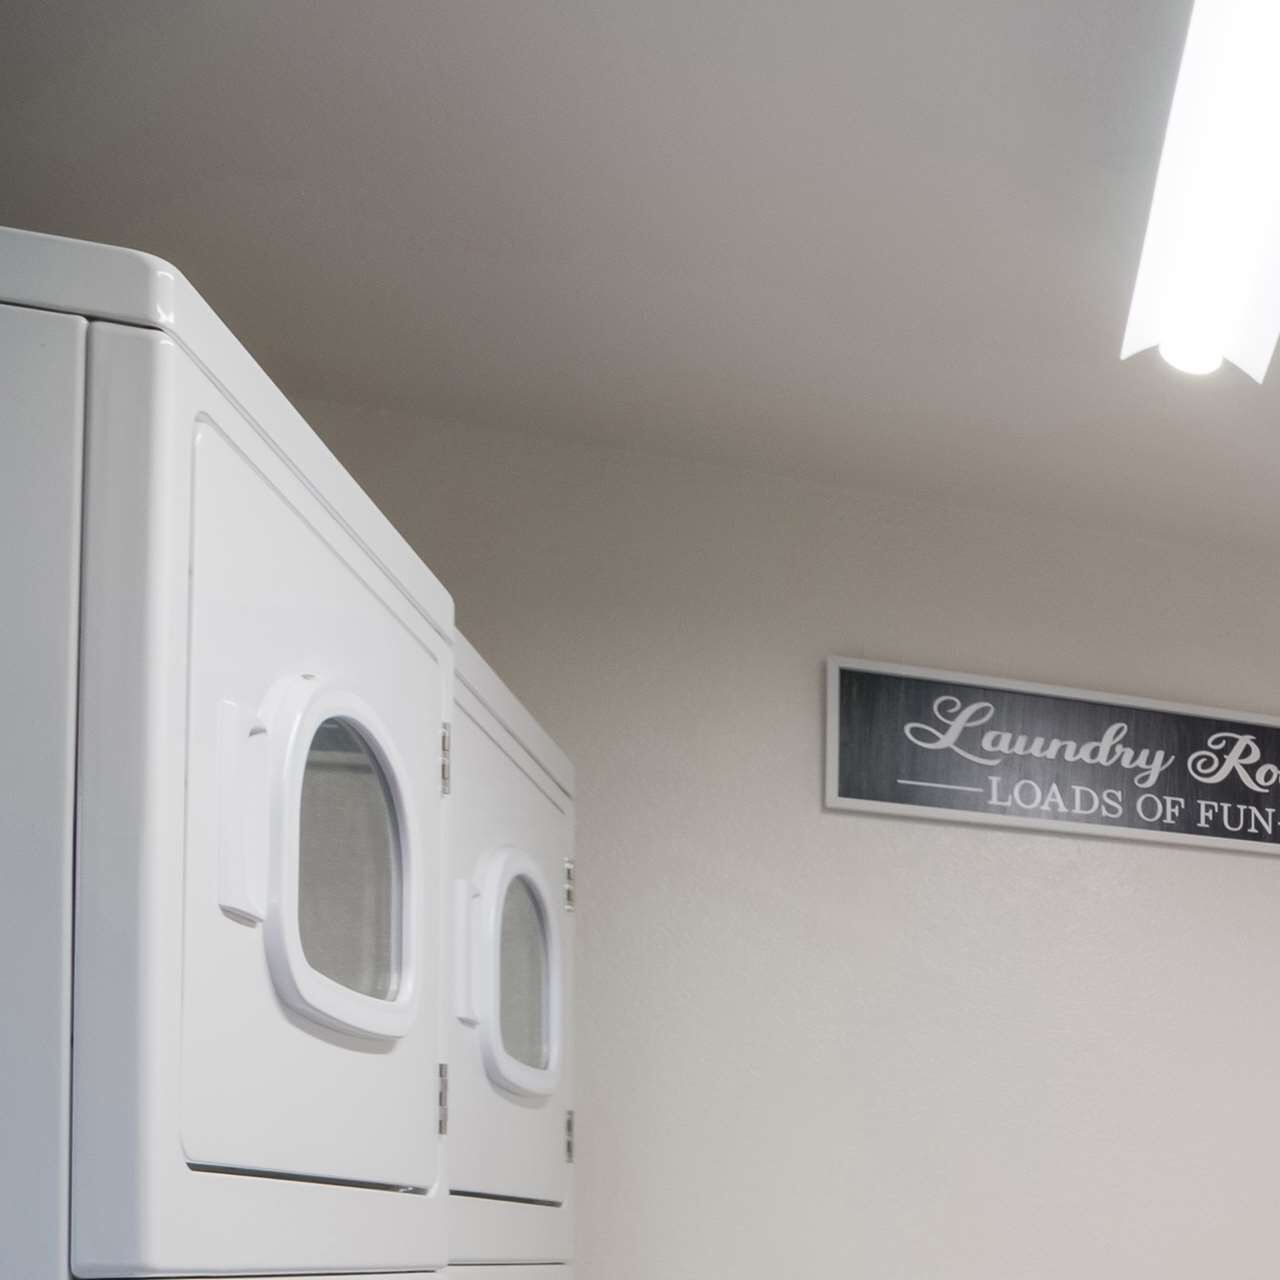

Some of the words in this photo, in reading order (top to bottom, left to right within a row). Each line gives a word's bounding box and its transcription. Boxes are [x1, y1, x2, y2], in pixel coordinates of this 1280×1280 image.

[904, 695, 1175, 787] Laundry
[988, 776, 1123, 818] LOADS
[1136, 796, 1185, 824] OF
[1197, 800, 1275, 834] FUN
